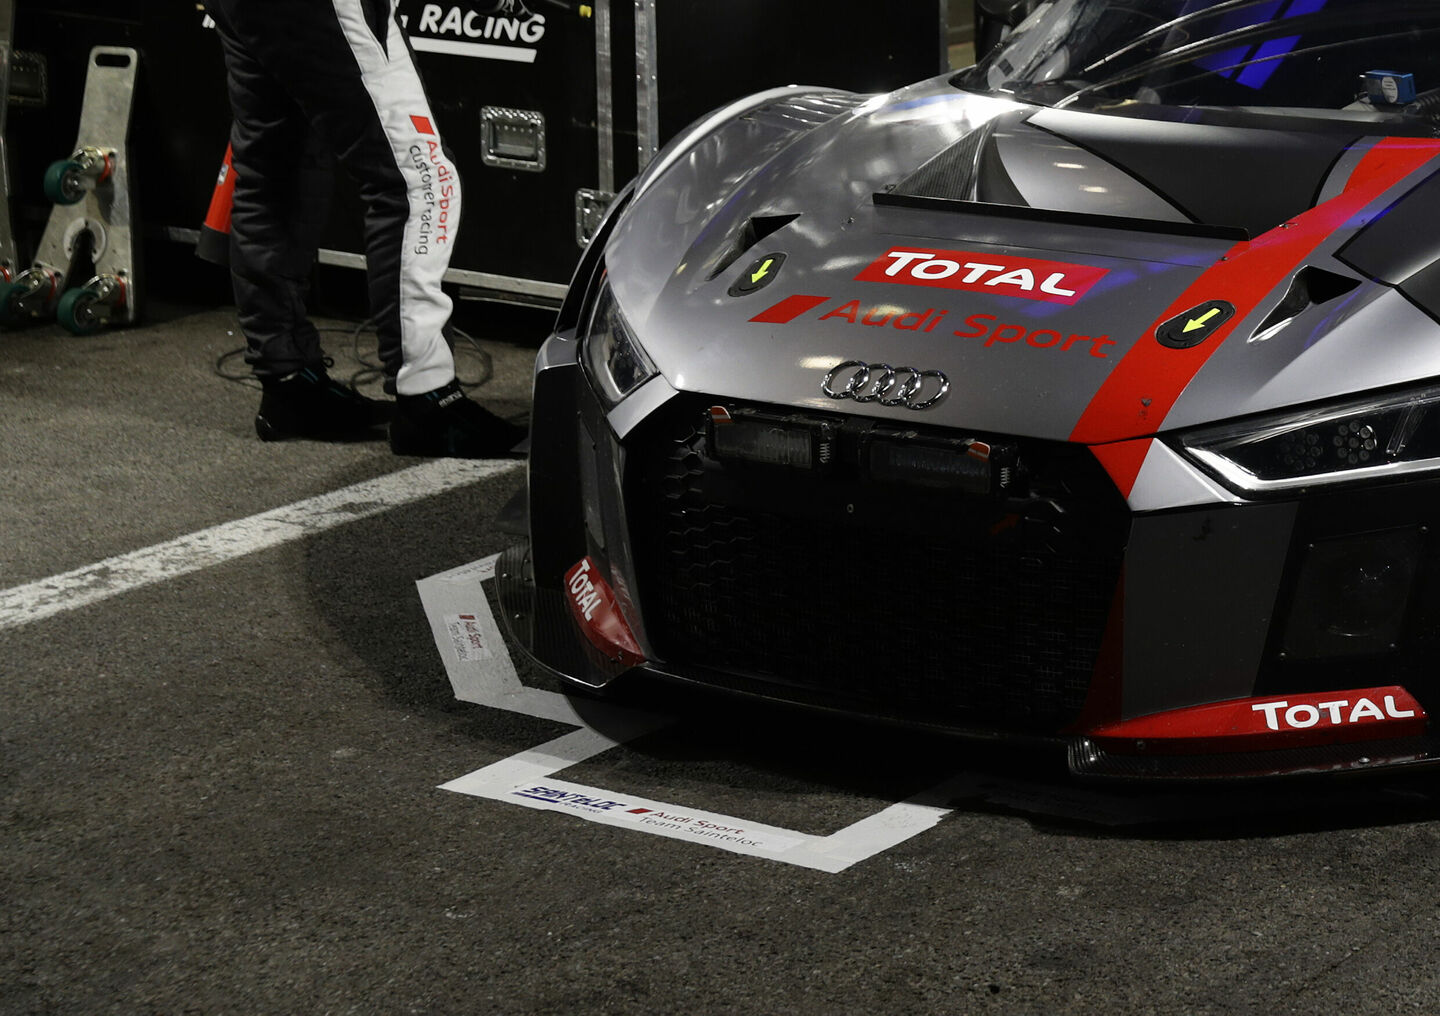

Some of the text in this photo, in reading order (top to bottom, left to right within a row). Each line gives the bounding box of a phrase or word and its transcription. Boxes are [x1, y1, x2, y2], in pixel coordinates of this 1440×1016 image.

[419, 3, 546, 44] RACING
[426, 140, 454, 244] Audi Sport
[885, 251, 1077, 297] TOTAL
[818, 298, 1118, 359] Audi Sport
[569, 558, 602, 623] TOTAL
[1252, 694, 1415, 731] TOTAL
[639, 816, 683, 831] Team
[683, 825, 763, 847] Sainteloc
[652, 811, 693, 825] Audi
[694, 819, 745, 835] Sport
